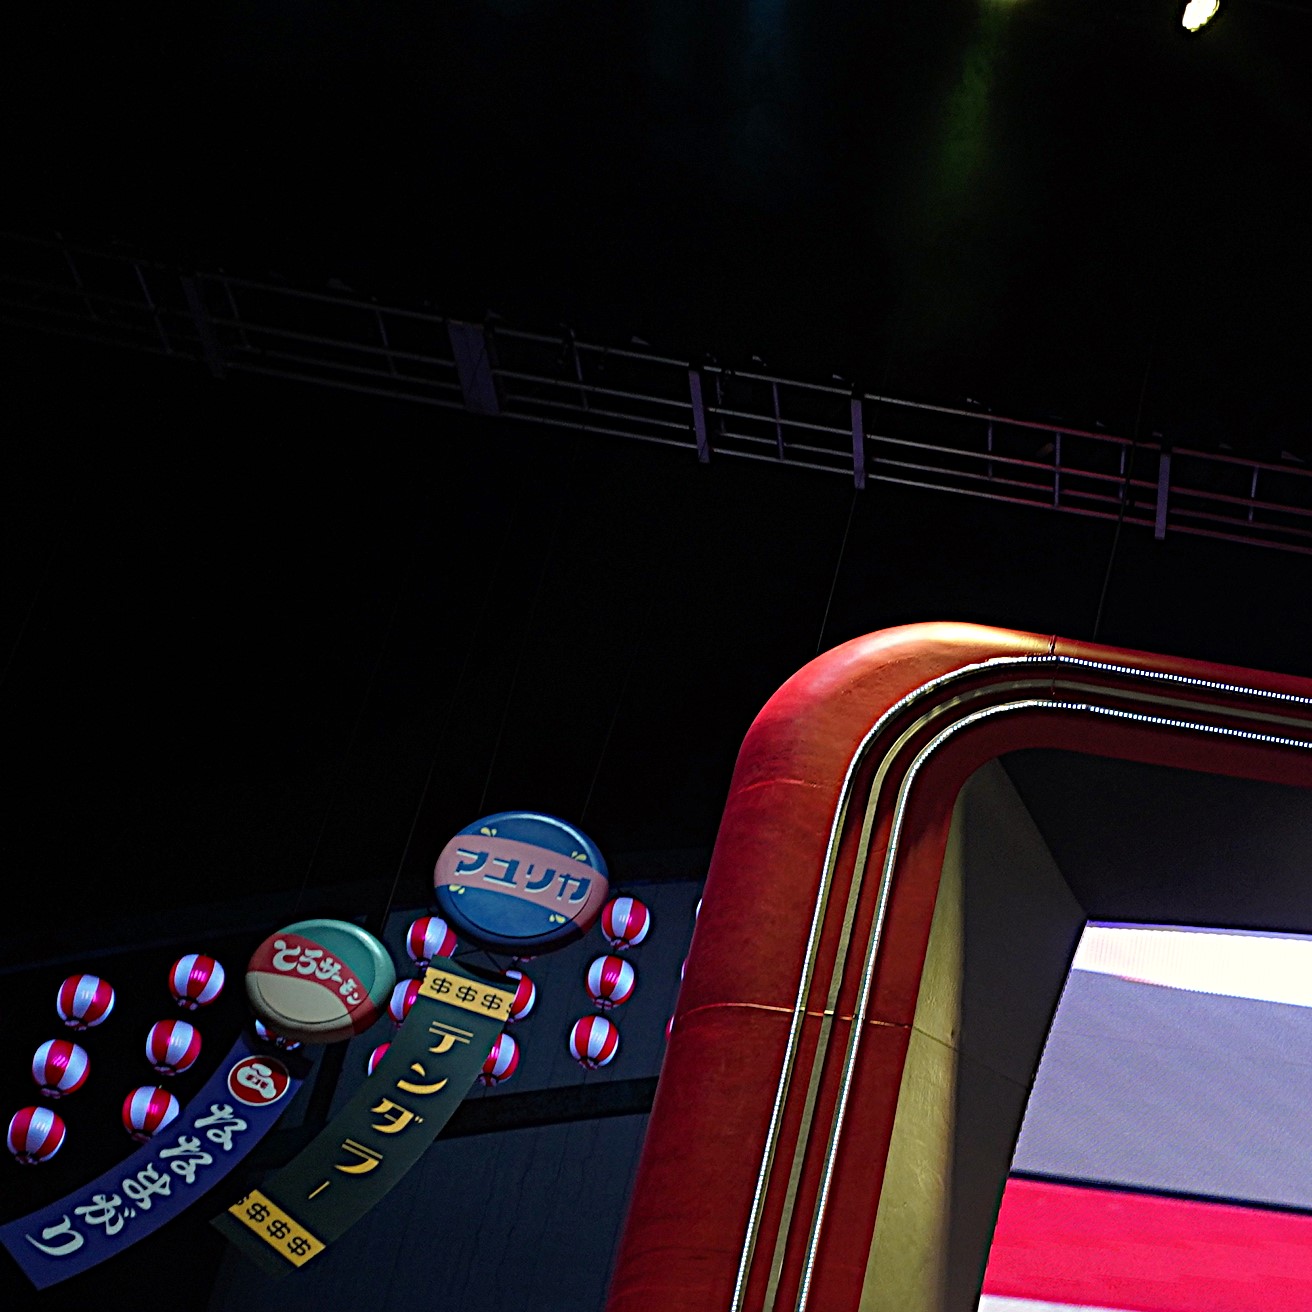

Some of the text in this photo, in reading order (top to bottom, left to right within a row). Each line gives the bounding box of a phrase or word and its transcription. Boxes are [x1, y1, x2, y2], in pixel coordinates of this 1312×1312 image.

[454, 847, 592, 906] マユリカ
[271, 938, 363, 1006] とろサーモン
[306, 1019, 475, 1201] テンダラー
[24, 1102, 248, 1257] ななまがり
